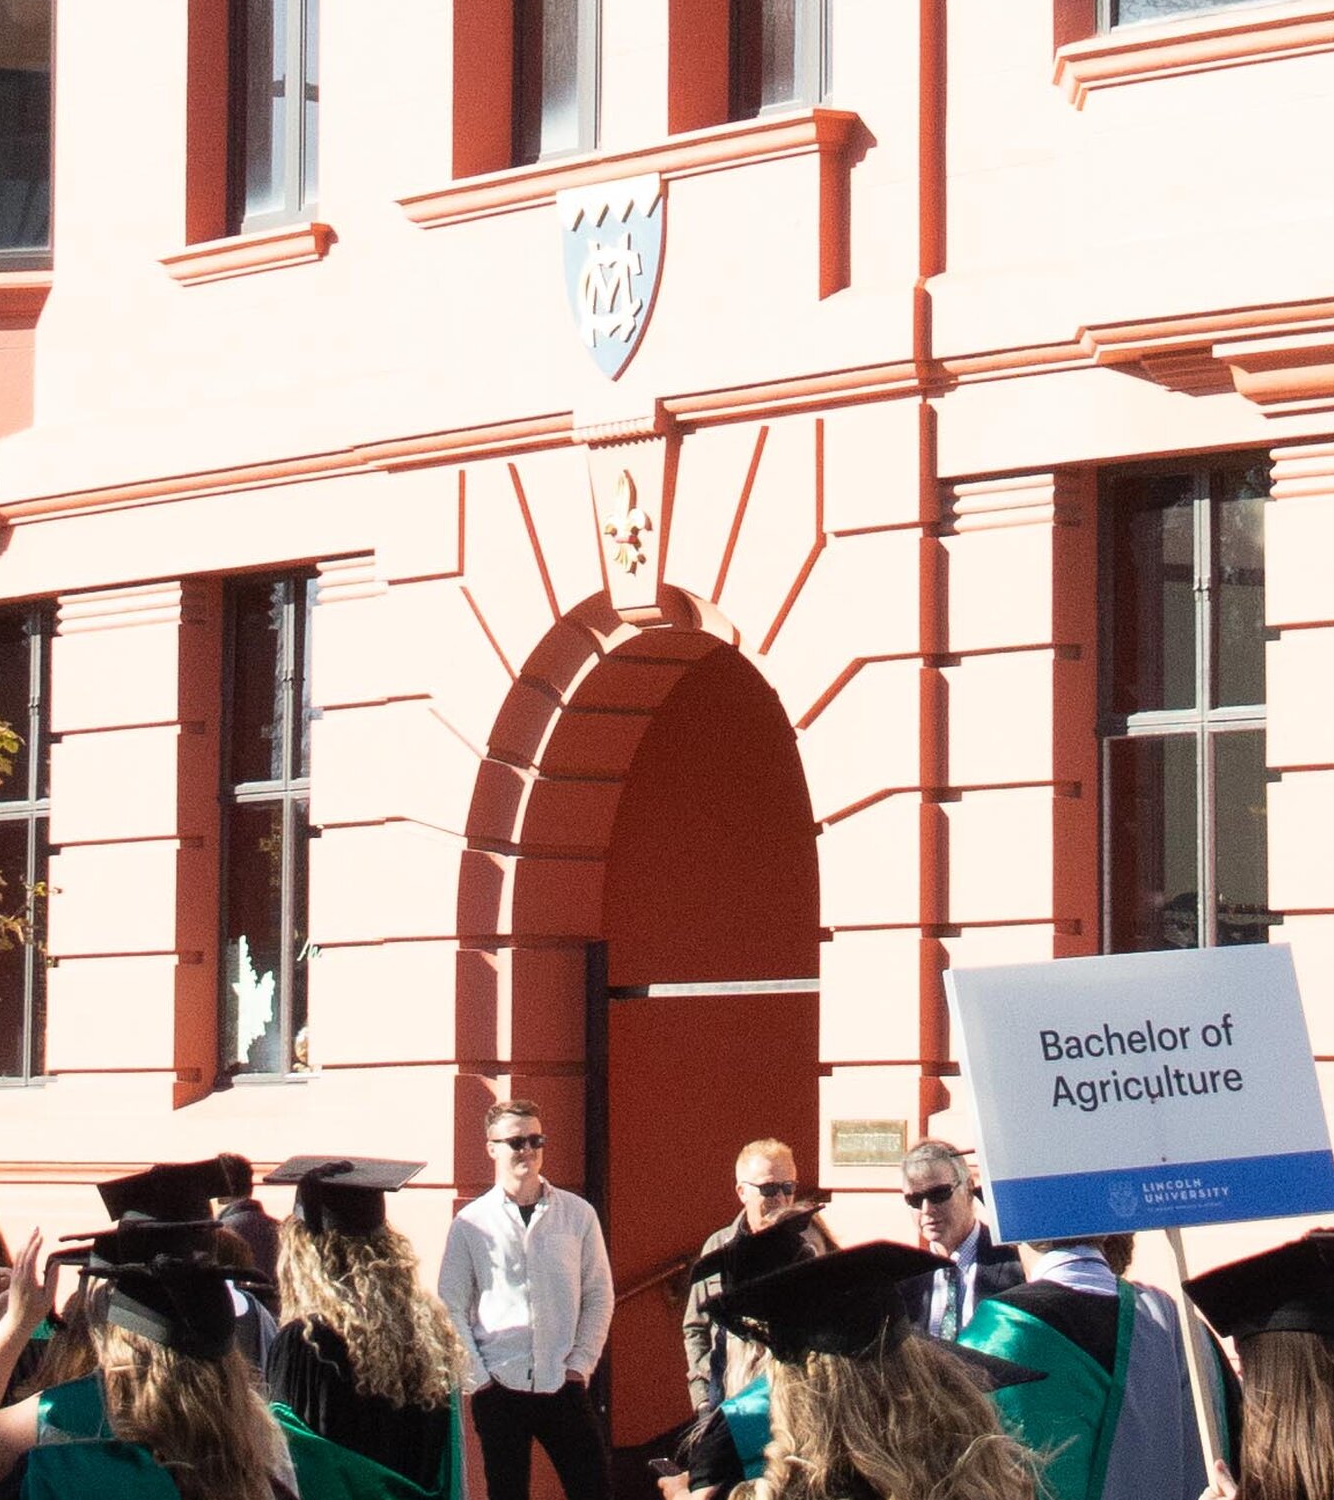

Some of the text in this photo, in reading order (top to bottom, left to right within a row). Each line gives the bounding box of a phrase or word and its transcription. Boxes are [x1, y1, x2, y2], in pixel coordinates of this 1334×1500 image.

[1040, 1013, 1233, 1061] Bachelor of
[1053, 1065, 1244, 1112] Agriculture
[1142, 1178, 1201, 1193] LINCOLN
[1145, 1186, 1229, 1203] UNIVERSITY
